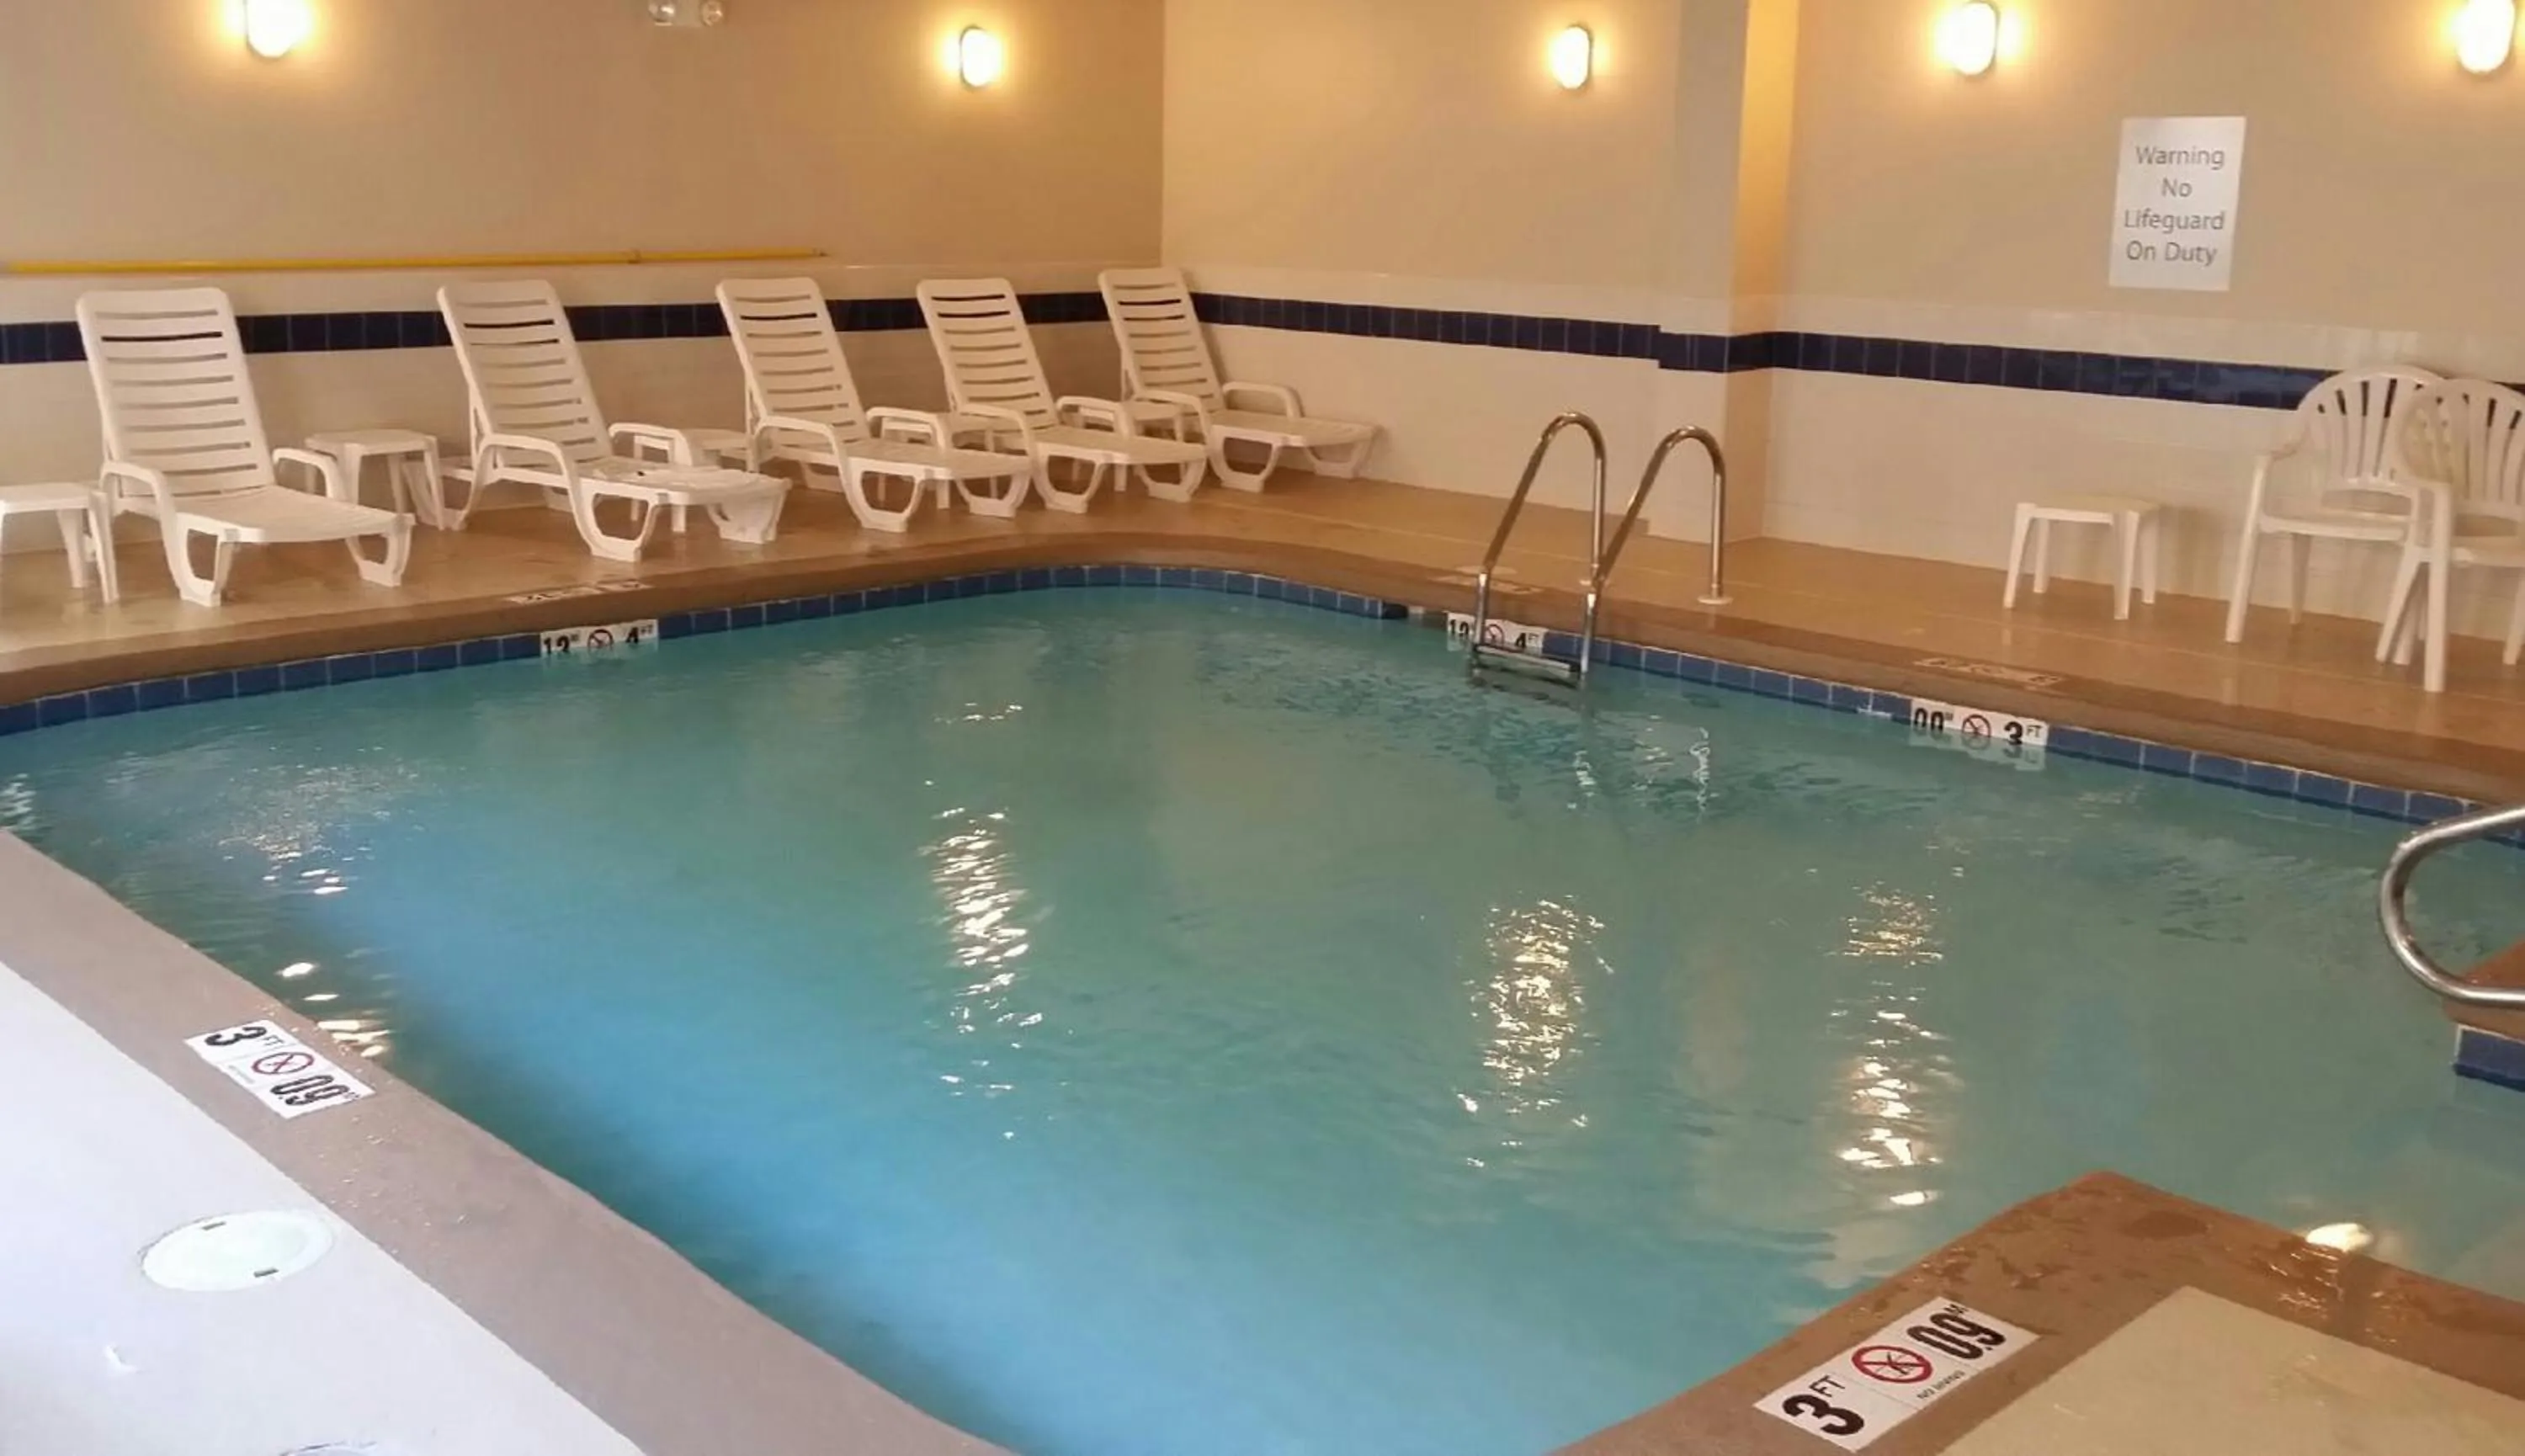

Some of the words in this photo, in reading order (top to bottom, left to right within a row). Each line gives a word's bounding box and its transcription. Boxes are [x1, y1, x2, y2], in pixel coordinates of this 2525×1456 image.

[2136, 146, 2225, 170] Warning
[2161, 178, 2193, 197] No
[2124, 208, 2225, 234] Lifeguard
[2126, 240, 2156, 261] On
[2164, 242, 2217, 266] Duty
[205, 1026, 268, 1046] 3
[1809, 1375, 1846, 1398] FT
[1782, 1395, 1864, 1436] 3
